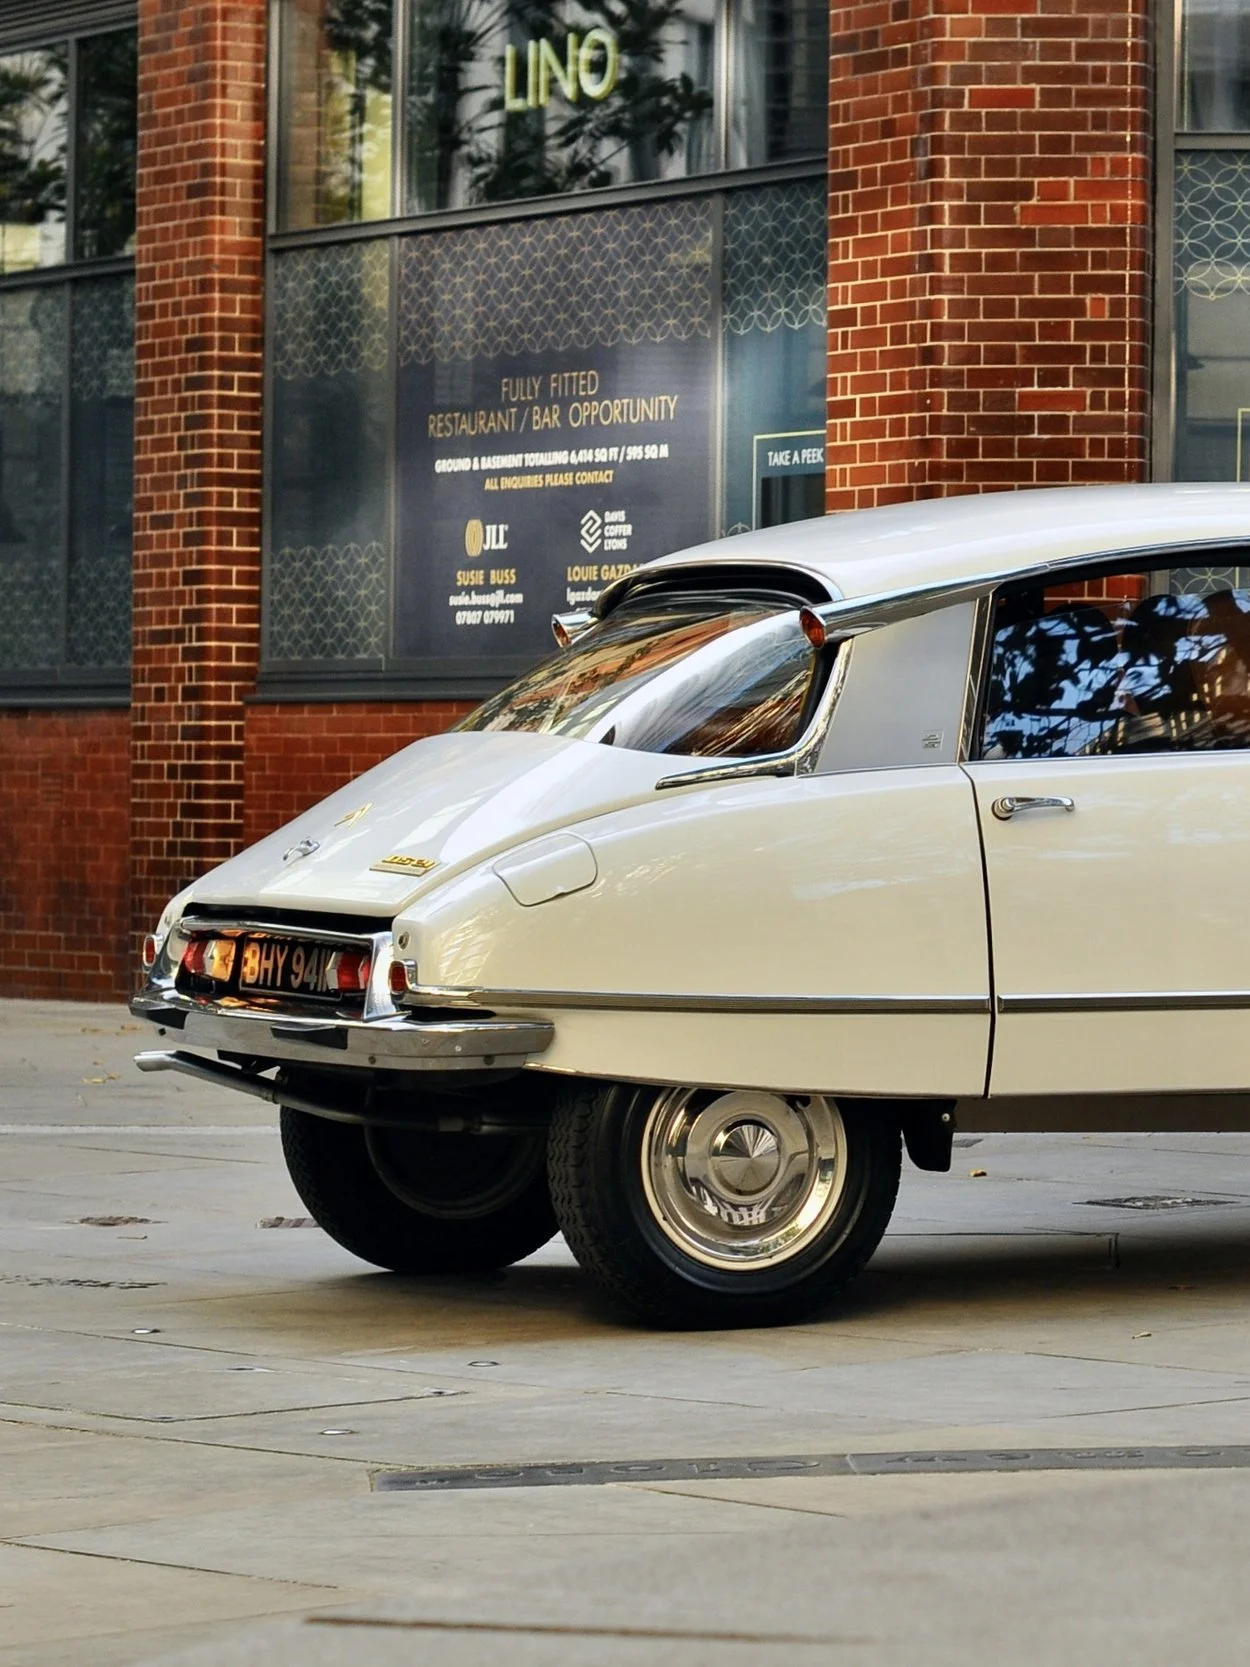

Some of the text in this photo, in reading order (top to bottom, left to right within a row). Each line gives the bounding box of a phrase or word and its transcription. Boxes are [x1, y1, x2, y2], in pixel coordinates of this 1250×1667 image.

[505, 28, 619, 112] LINO
[501, 370, 599, 402] FULLY FITTED
[428, 408, 517, 438] RESTAURANT
[532, 404, 561, 430] BAR
[569, 395, 679, 428] OPPORTUNITY
[435, 458, 471, 473] GROUND
[480, 453, 524, 470] BASEMENT
[524, 450, 569, 467] TOTALLING
[594, 447, 608, 463] SQ
[608, 446, 618, 461] FT
[644, 444, 659, 459] SQ
[659, 443, 669, 458] M
[768, 448, 824, 467] TAKE A PEEK
[484, 469, 615, 491] ALL ENQUIRIES PLEASE CONTACT
[604, 510, 626, 523] DAVIS
[604, 524, 633, 537] COFFER
[604, 538, 628, 551] LYONS
[456, 568, 516, 586] SUSIE BUSS
[567, 565, 598, 582] LOUIE
[243, 942, 289, 987] BHY
